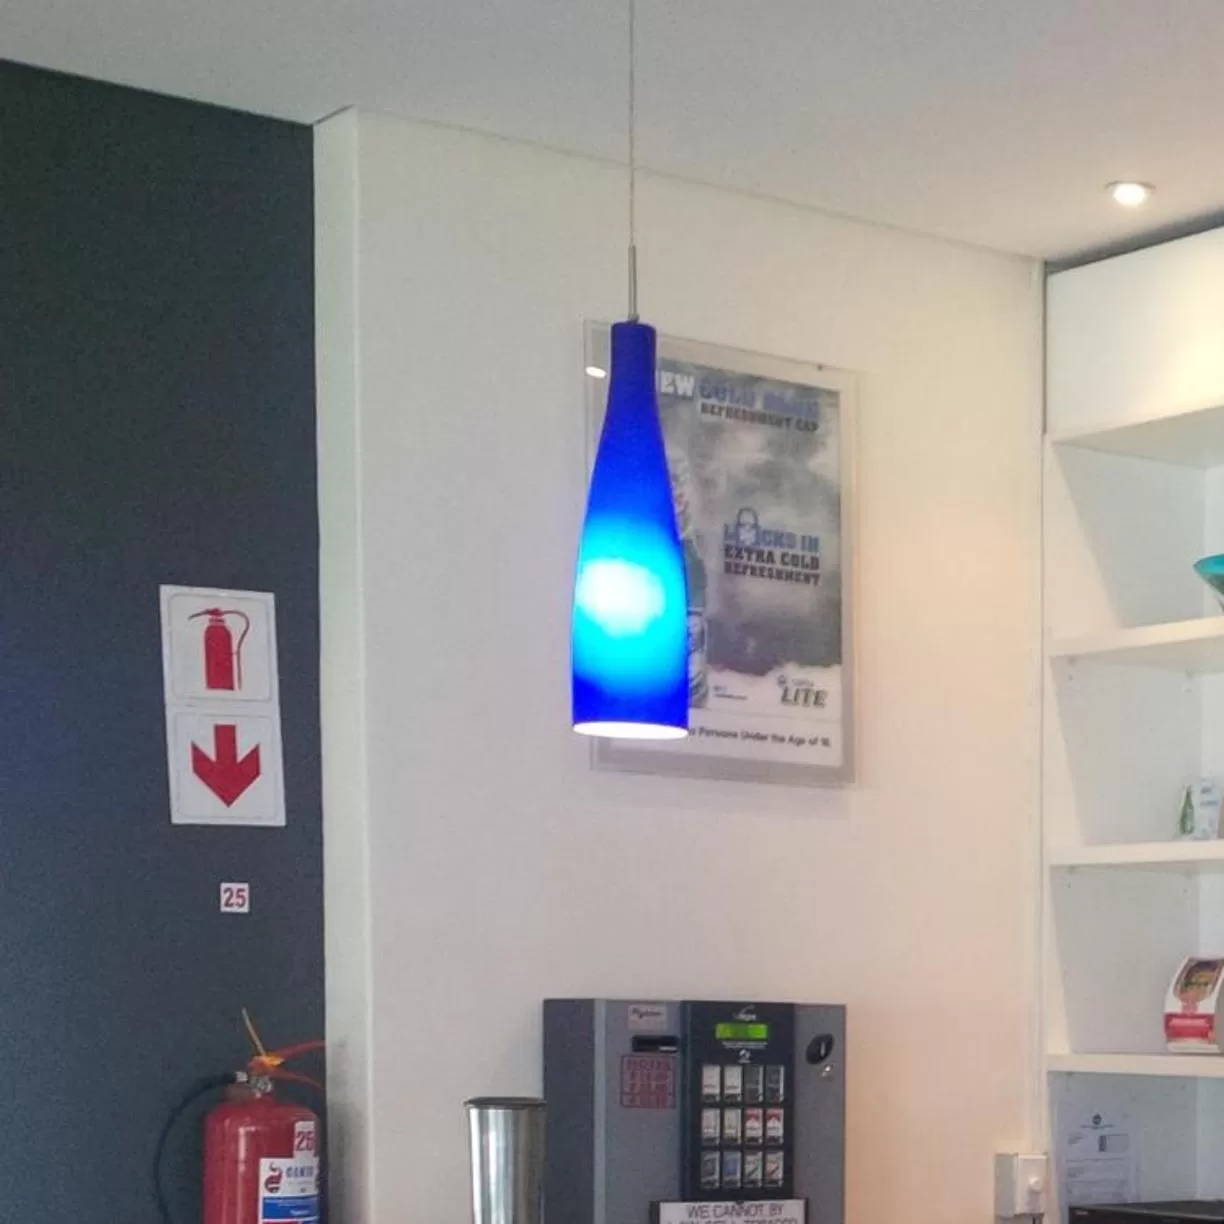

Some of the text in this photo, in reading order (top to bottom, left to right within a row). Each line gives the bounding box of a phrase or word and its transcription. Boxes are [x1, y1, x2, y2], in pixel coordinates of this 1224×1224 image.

[661, 371, 695, 397] EW
[724, 543, 820, 570] EXTRA COLD
[724, 561, 821, 587] REFRESHMENT
[781, 686, 828, 708] LITE
[741, 730, 768, 741] Under
[771, 733, 785, 743] the
[788, 735, 806, 747] Age
[223, 887, 246, 908] 25
[687, 1203, 785, 1219] WE CANNOT BY
